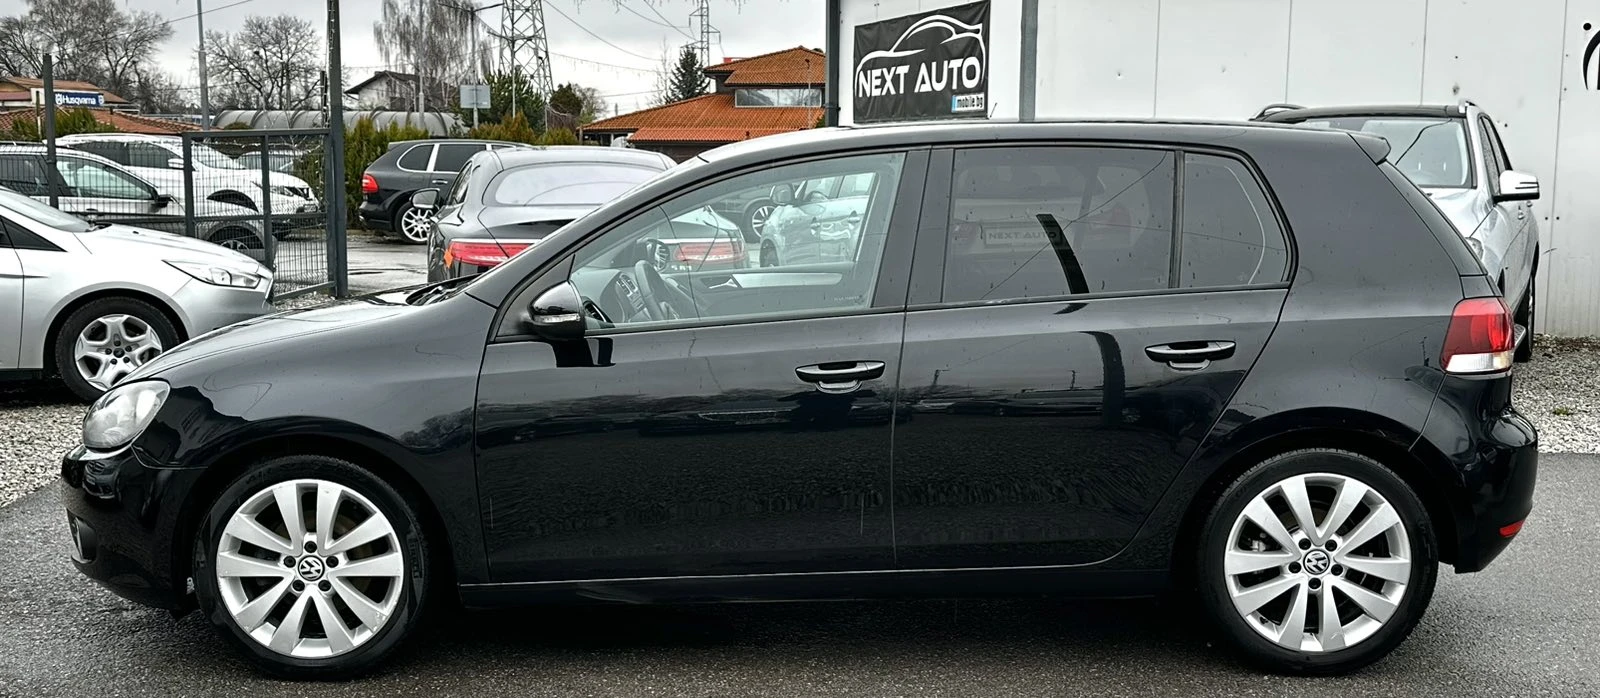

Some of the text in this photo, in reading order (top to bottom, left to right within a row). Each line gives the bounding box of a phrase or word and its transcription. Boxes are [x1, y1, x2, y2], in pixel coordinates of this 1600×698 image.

[858, 56, 981, 98] NEXT AUTO
[62, 94, 97, 105] Husqvarna
